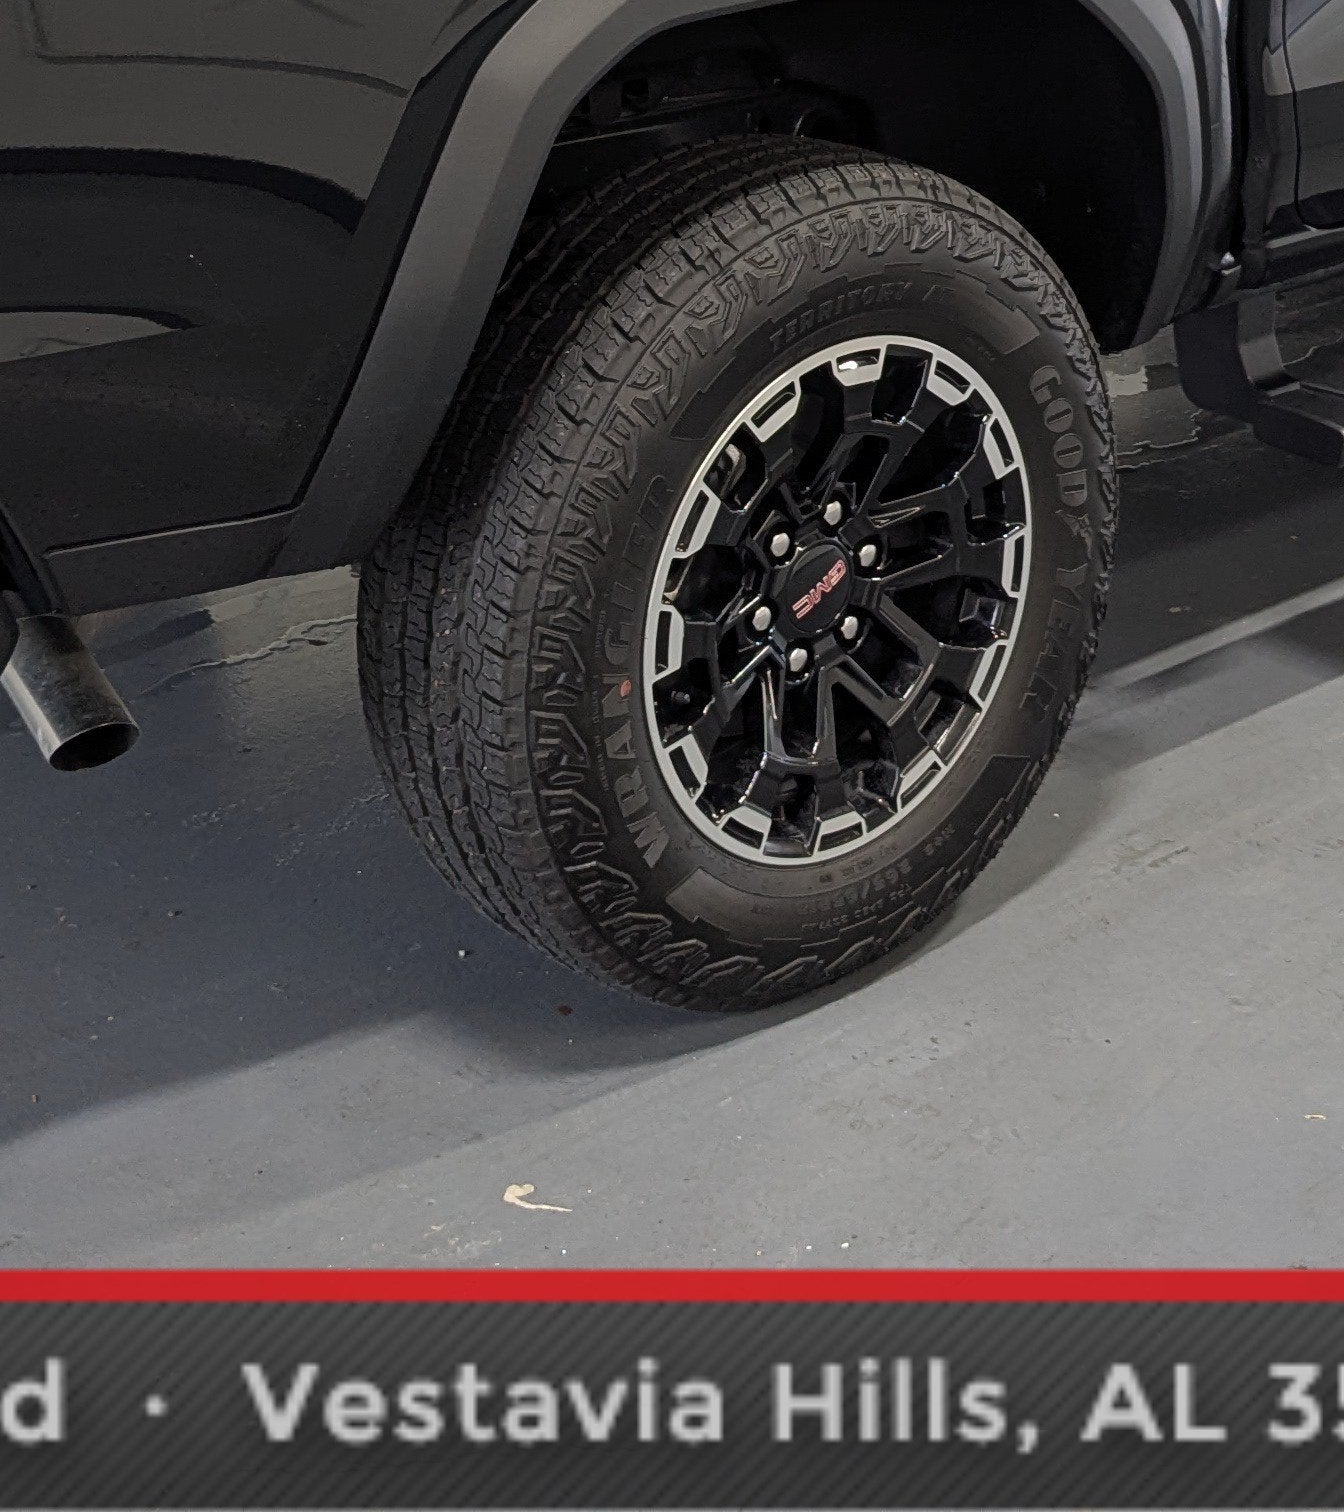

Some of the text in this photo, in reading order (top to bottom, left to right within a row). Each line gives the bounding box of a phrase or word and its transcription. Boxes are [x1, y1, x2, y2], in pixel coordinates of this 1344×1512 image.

[769, 281, 913, 353] TERRITORY
[792, 559, 847, 620] GMC
[602, 473, 675, 869] WRANGLER
